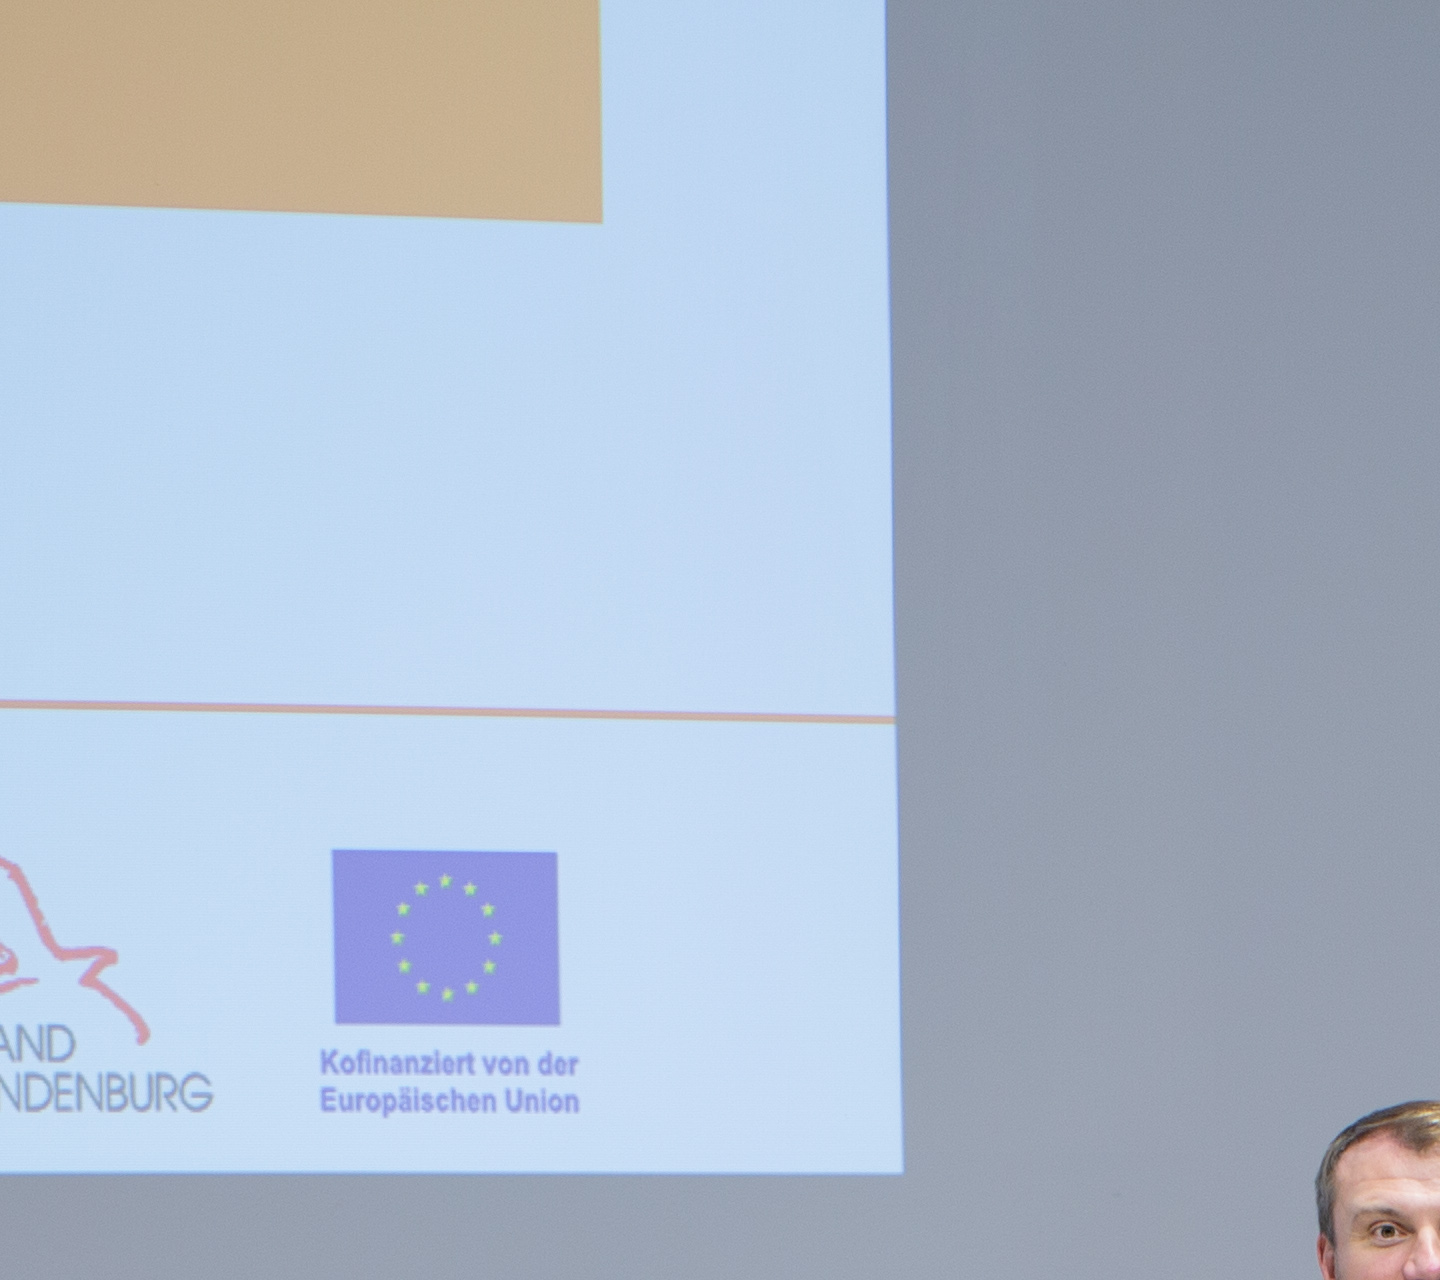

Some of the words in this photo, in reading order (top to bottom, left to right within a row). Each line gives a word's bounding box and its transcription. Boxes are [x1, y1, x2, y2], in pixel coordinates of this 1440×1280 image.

[320, 1048, 476, 1076] Kofinanziert
[482, 1054, 530, 1076] von
[537, 1050, 580, 1076] der
[320, 1086, 497, 1118] Europäischen
[505, 1087, 580, 1114] Union
